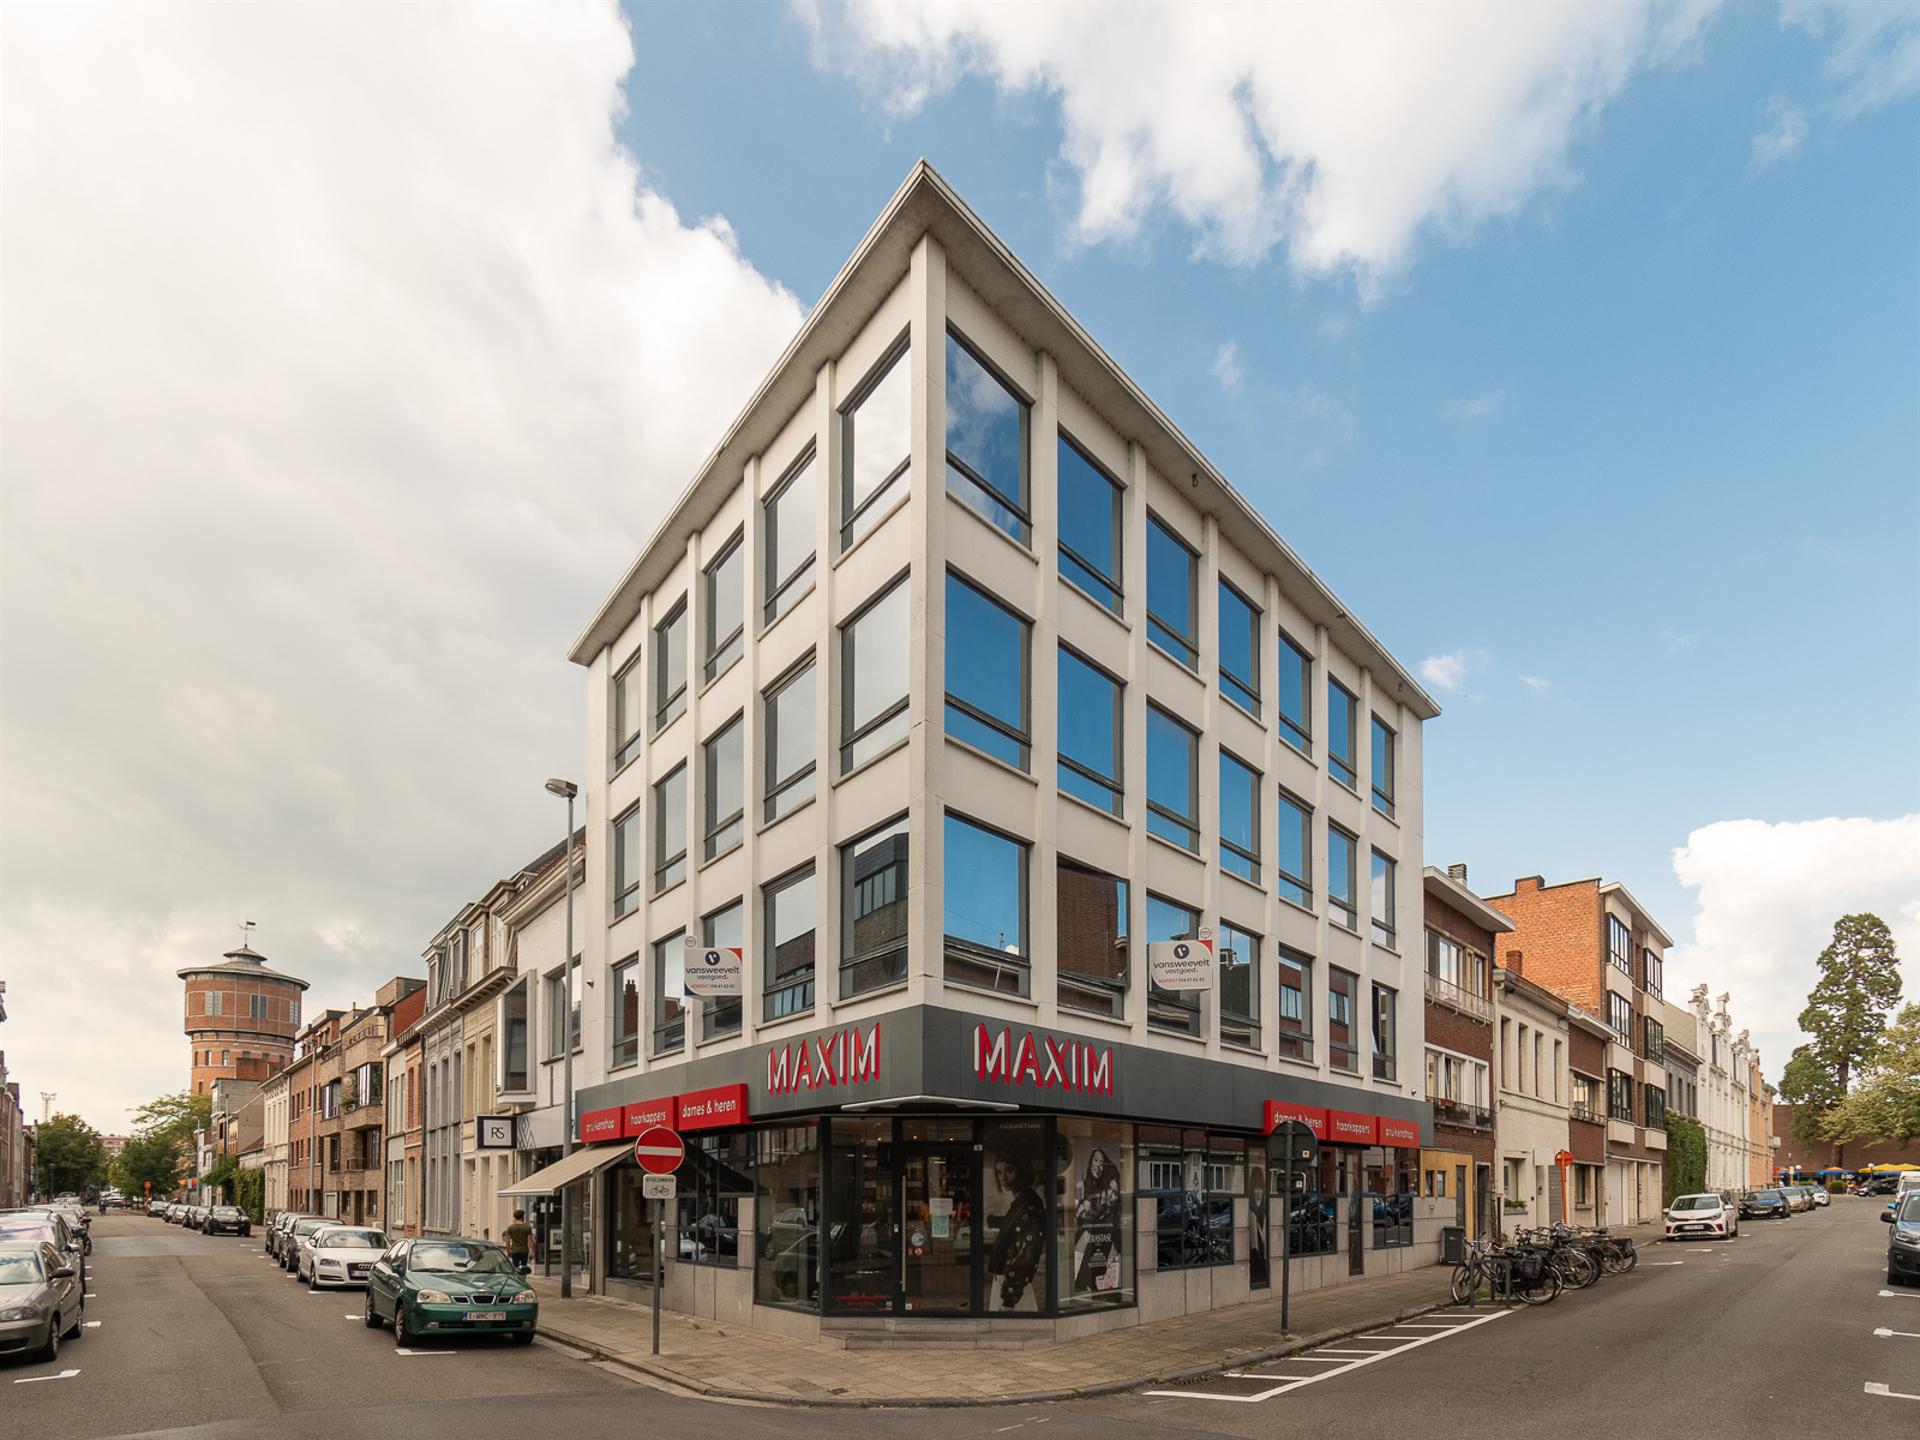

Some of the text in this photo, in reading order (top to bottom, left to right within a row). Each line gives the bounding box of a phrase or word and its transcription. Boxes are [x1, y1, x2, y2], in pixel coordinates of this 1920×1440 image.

[685, 966, 740, 974] vansweevelt
[1153, 959, 1210, 968] vansweevelt
[767, 1021, 881, 1097] MAXIM
[973, 1022, 1113, 1098] MAXIM
[682, 1098, 736, 1118] dames & heren
[630, 1110, 666, 1126] haarkappers
[1336, 1119, 1370, 1135] haarkappers
